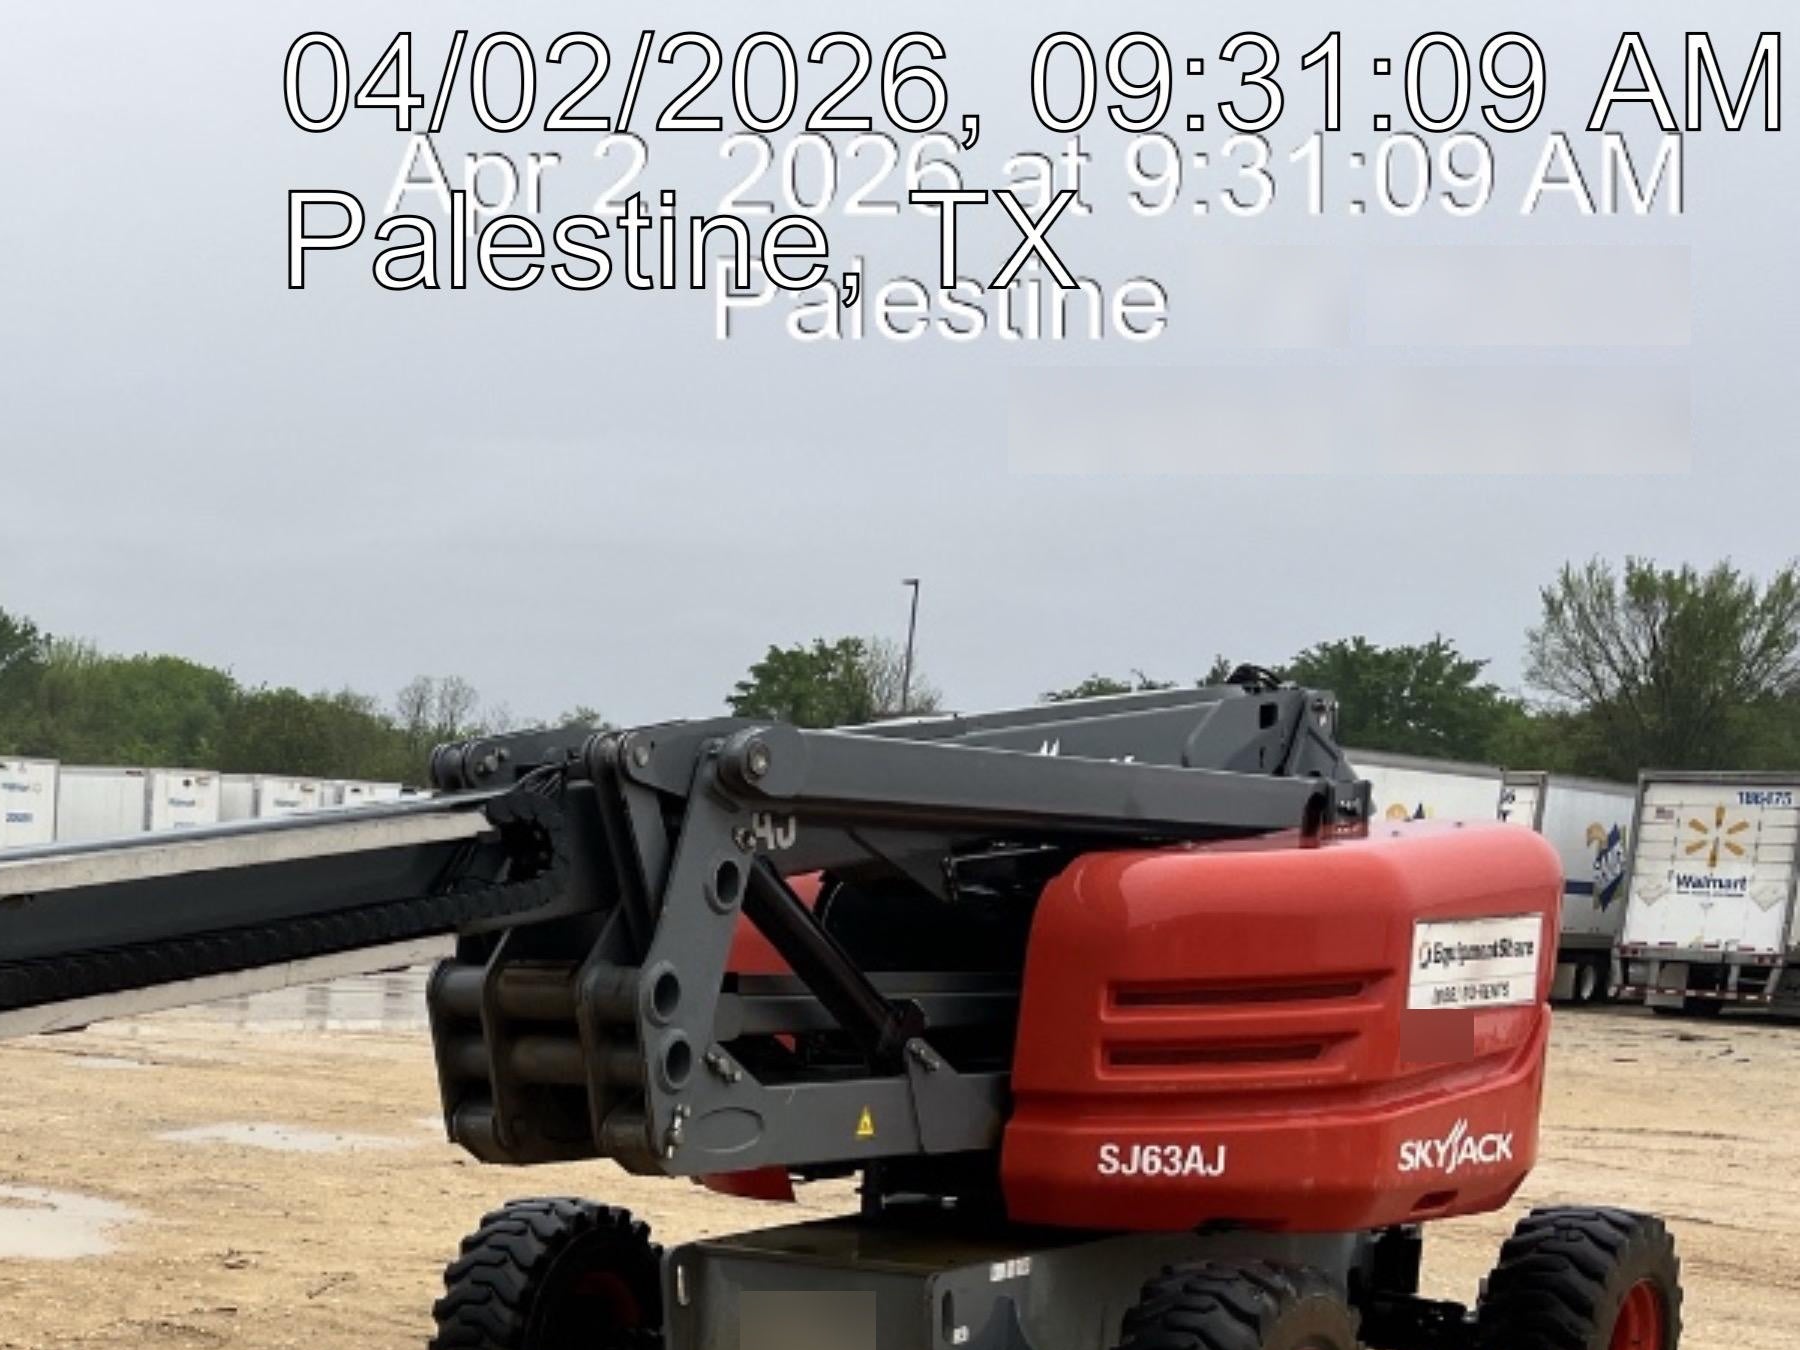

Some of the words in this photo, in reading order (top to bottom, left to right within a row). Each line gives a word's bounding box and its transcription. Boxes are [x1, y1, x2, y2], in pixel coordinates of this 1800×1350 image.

[1676, 873, 1747, 891] Walmart
[1098, 1144, 1226, 1177] SJ63AJ
[1398, 1119, 1513, 1174] SKYJACK
